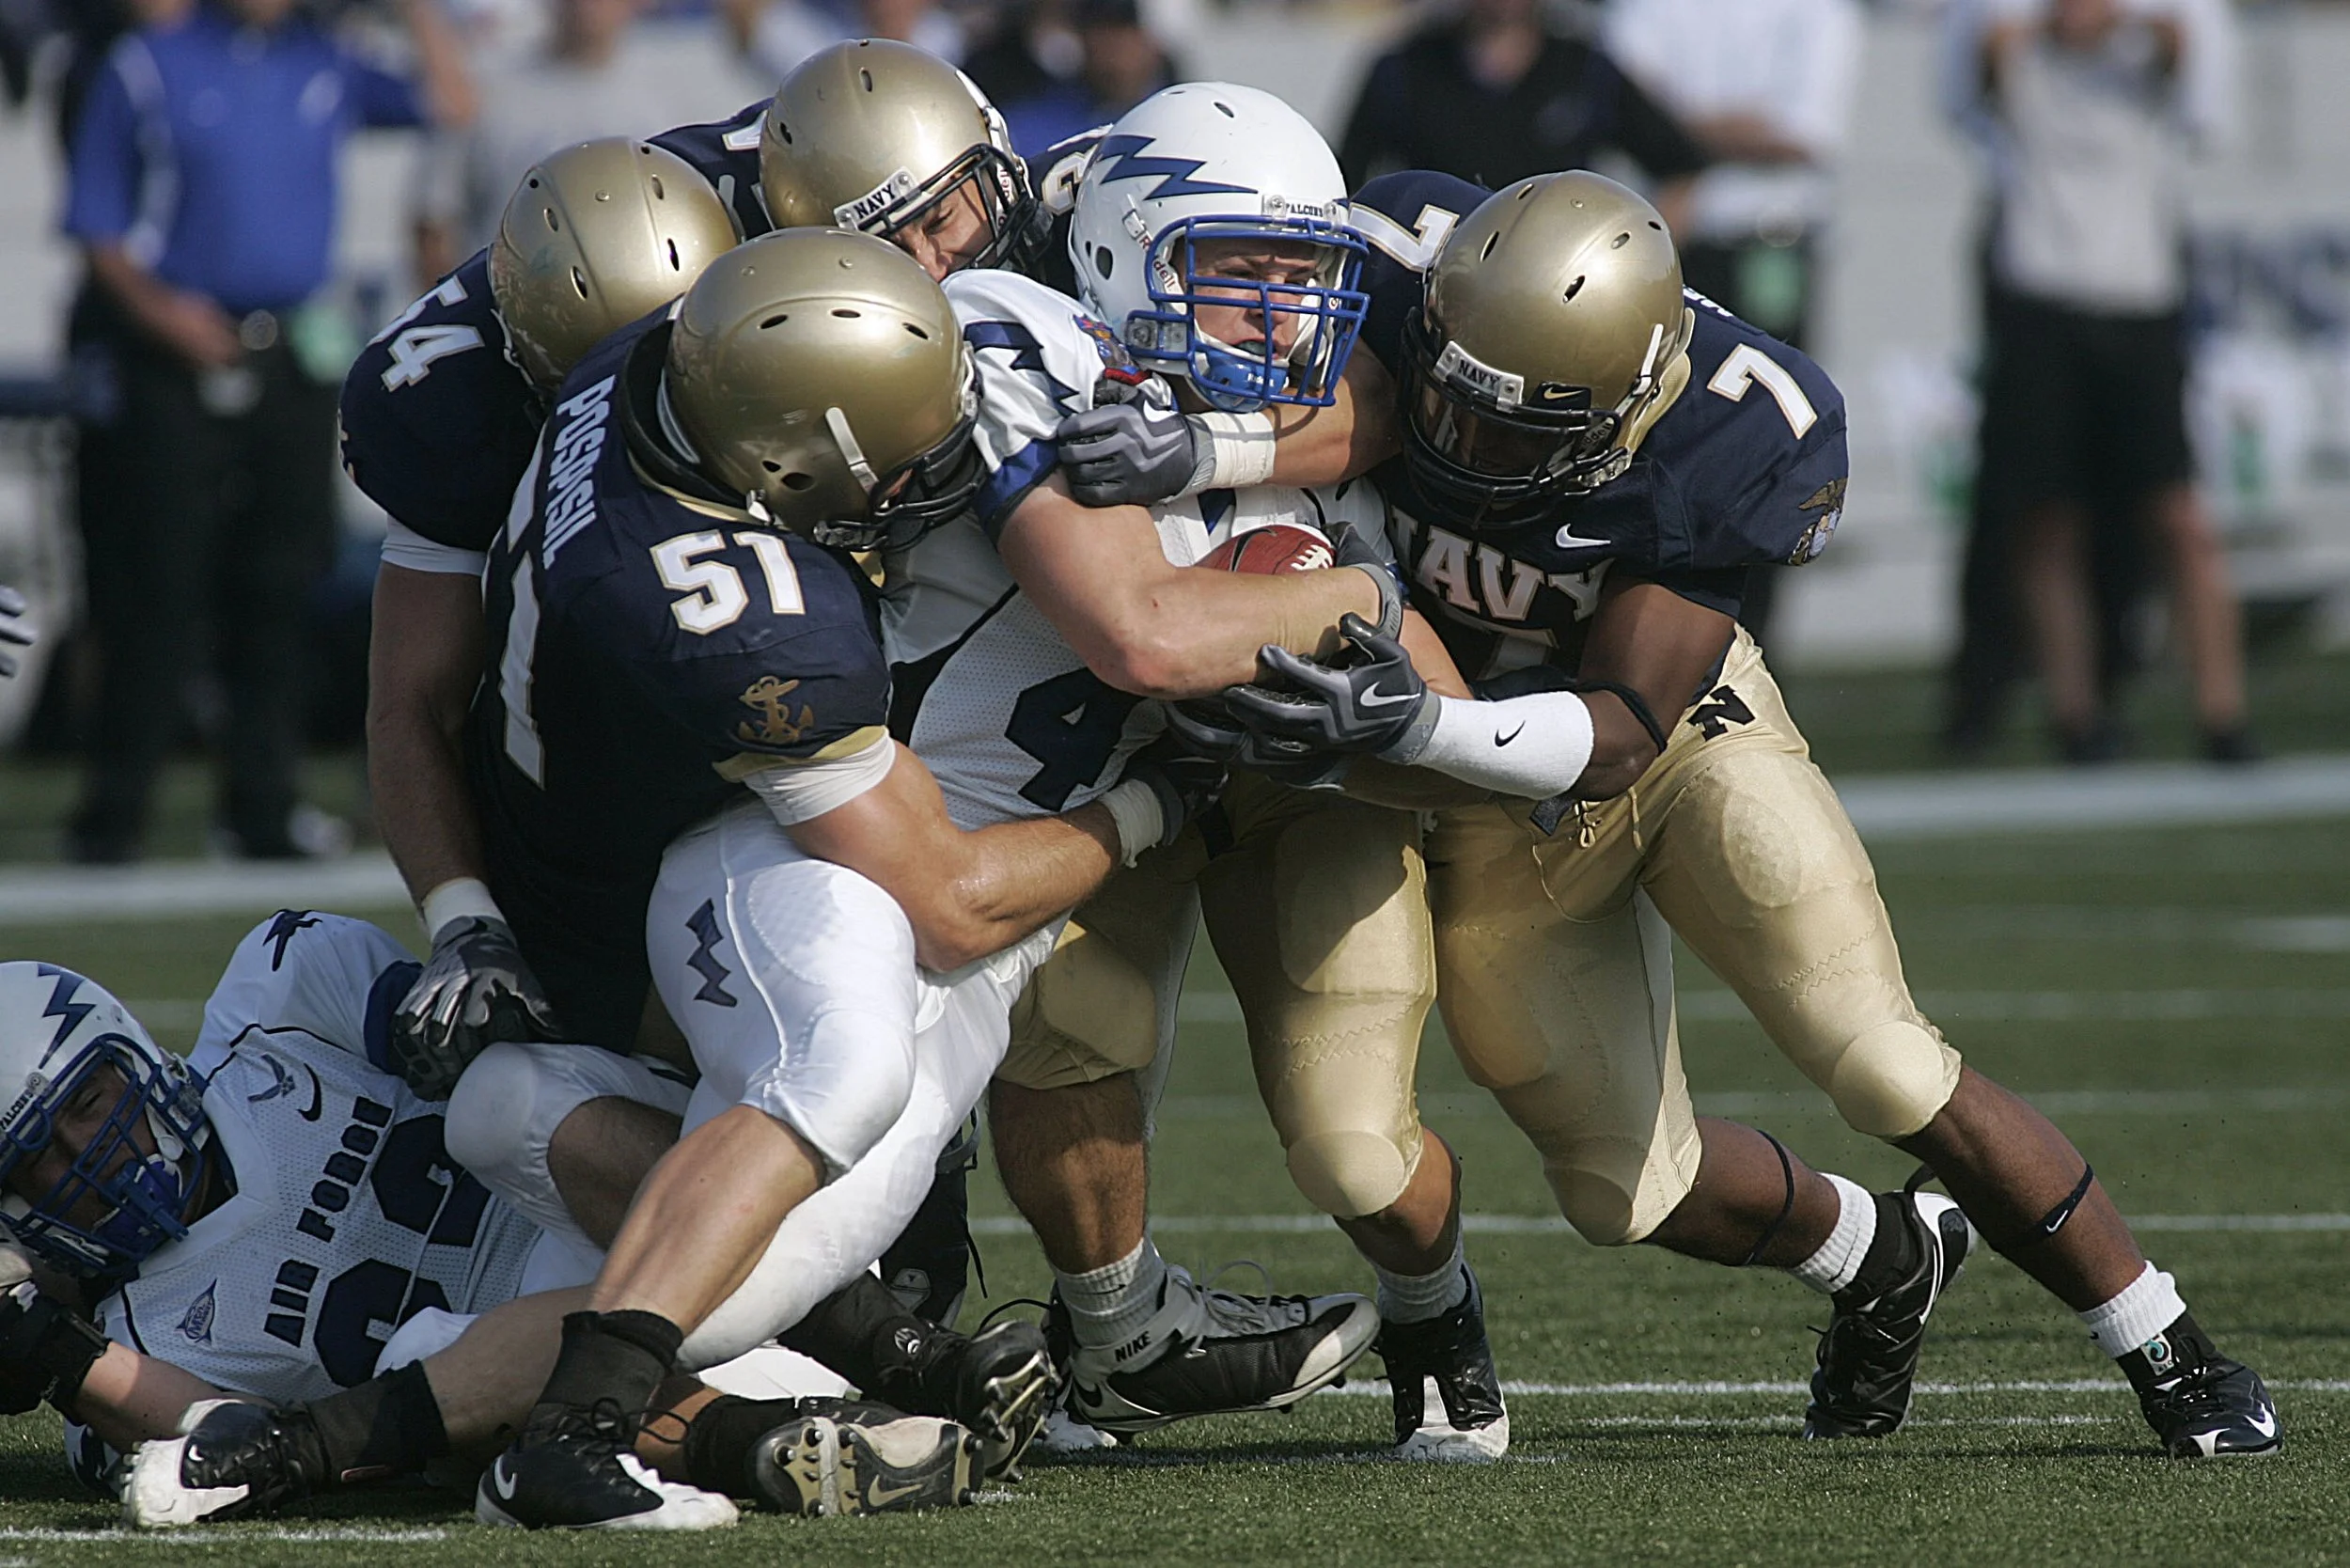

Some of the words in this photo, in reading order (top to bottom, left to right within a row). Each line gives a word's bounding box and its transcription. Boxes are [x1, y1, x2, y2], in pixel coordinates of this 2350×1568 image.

[854, 183, 896, 220] NAVY
[1138, 235, 1175, 289] Rdell
[1349, 201, 1460, 273] 7
[1458, 359, 1501, 390] NAVY
[1706, 343, 1817, 440] 7
[543, 373, 617, 571] POSPISIL
[649, 528, 807, 636] 51
[1686, 684, 1756, 742] N
[264, 1259, 320, 1348] AIR
[296, 1095, 393, 1243] FORCE
[1115, 1331, 1152, 1362] NIKE
